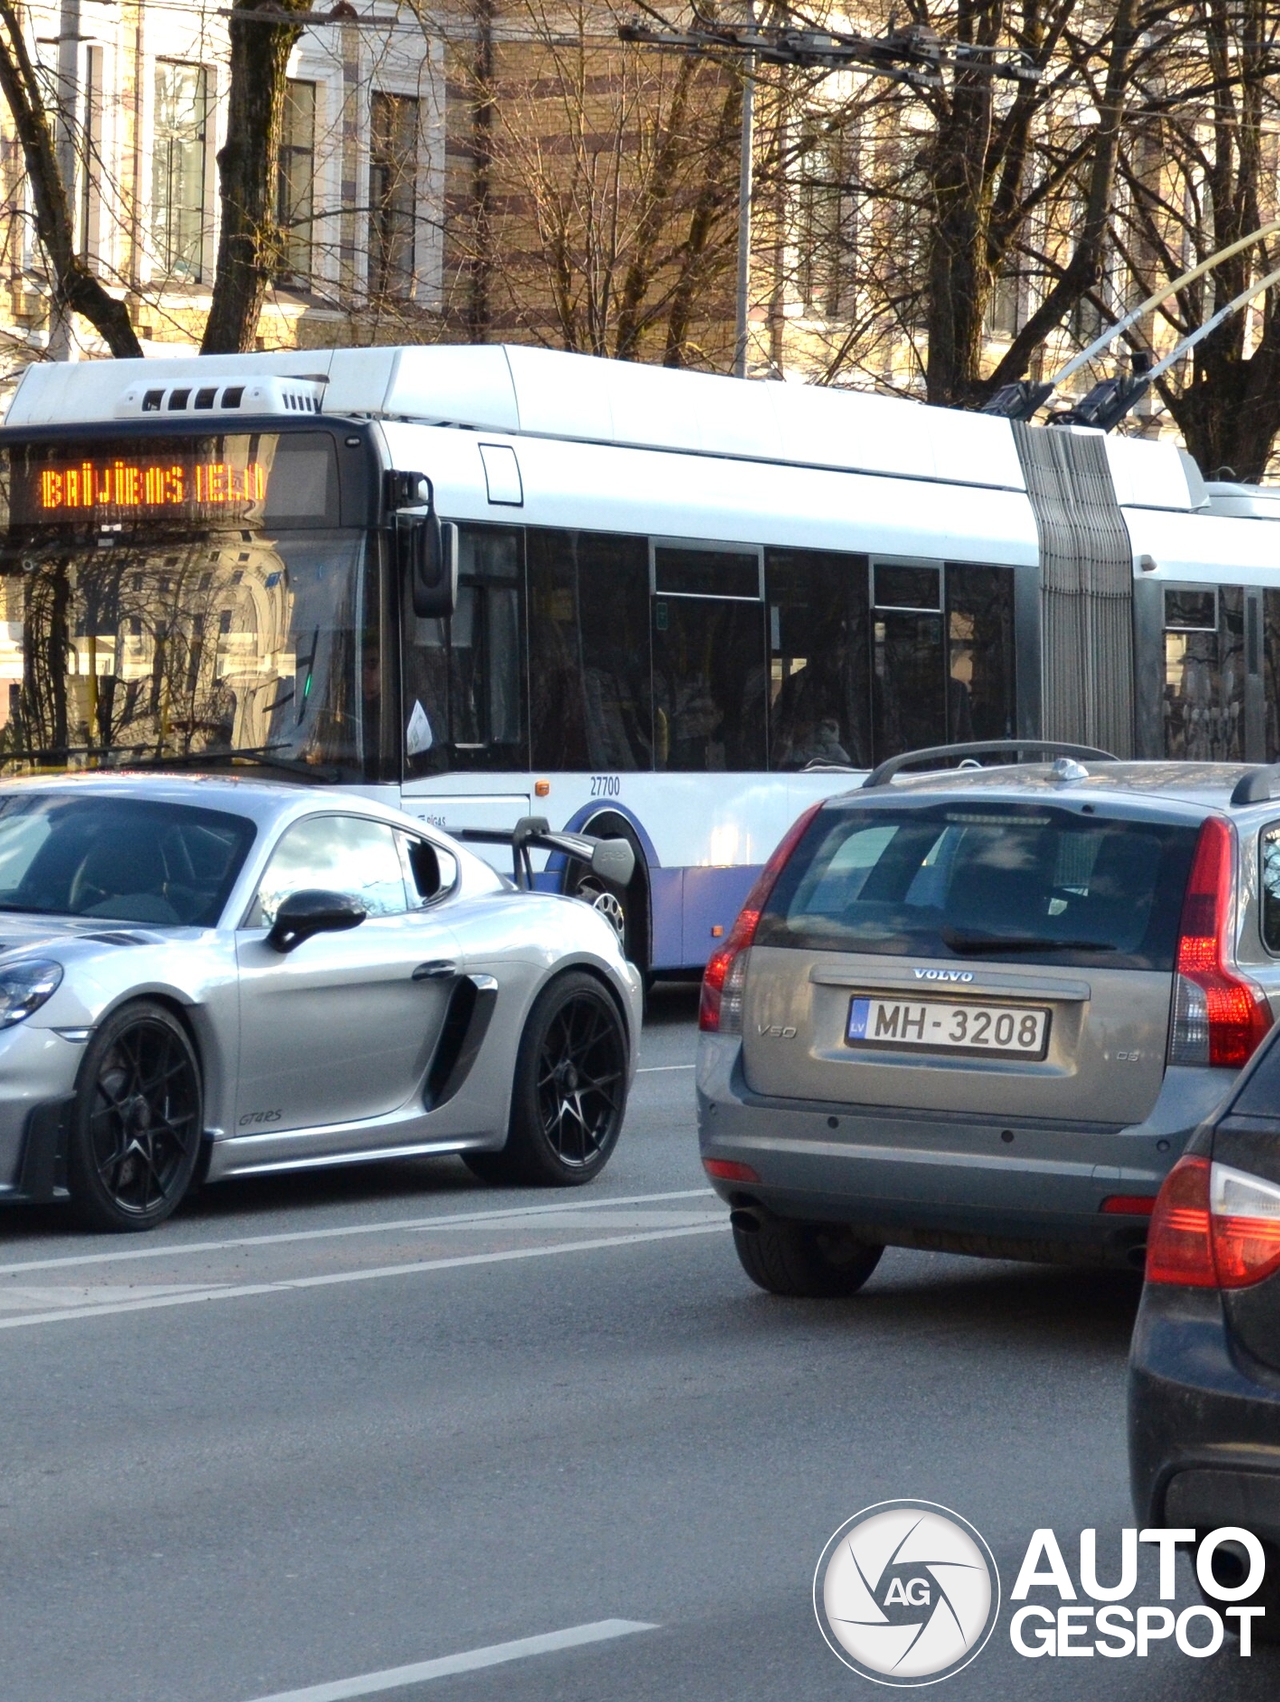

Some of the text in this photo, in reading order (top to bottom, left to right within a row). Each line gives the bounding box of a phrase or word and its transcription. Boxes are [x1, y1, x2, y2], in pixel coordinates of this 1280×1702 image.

[590, 776, 620, 796] 27700
[912, 968, 974, 982] VOLVO
[757, 1024, 797, 1039] V50
[851, 1022, 865, 1033] LV
[874, 1004, 1038, 1048] MH-3208
